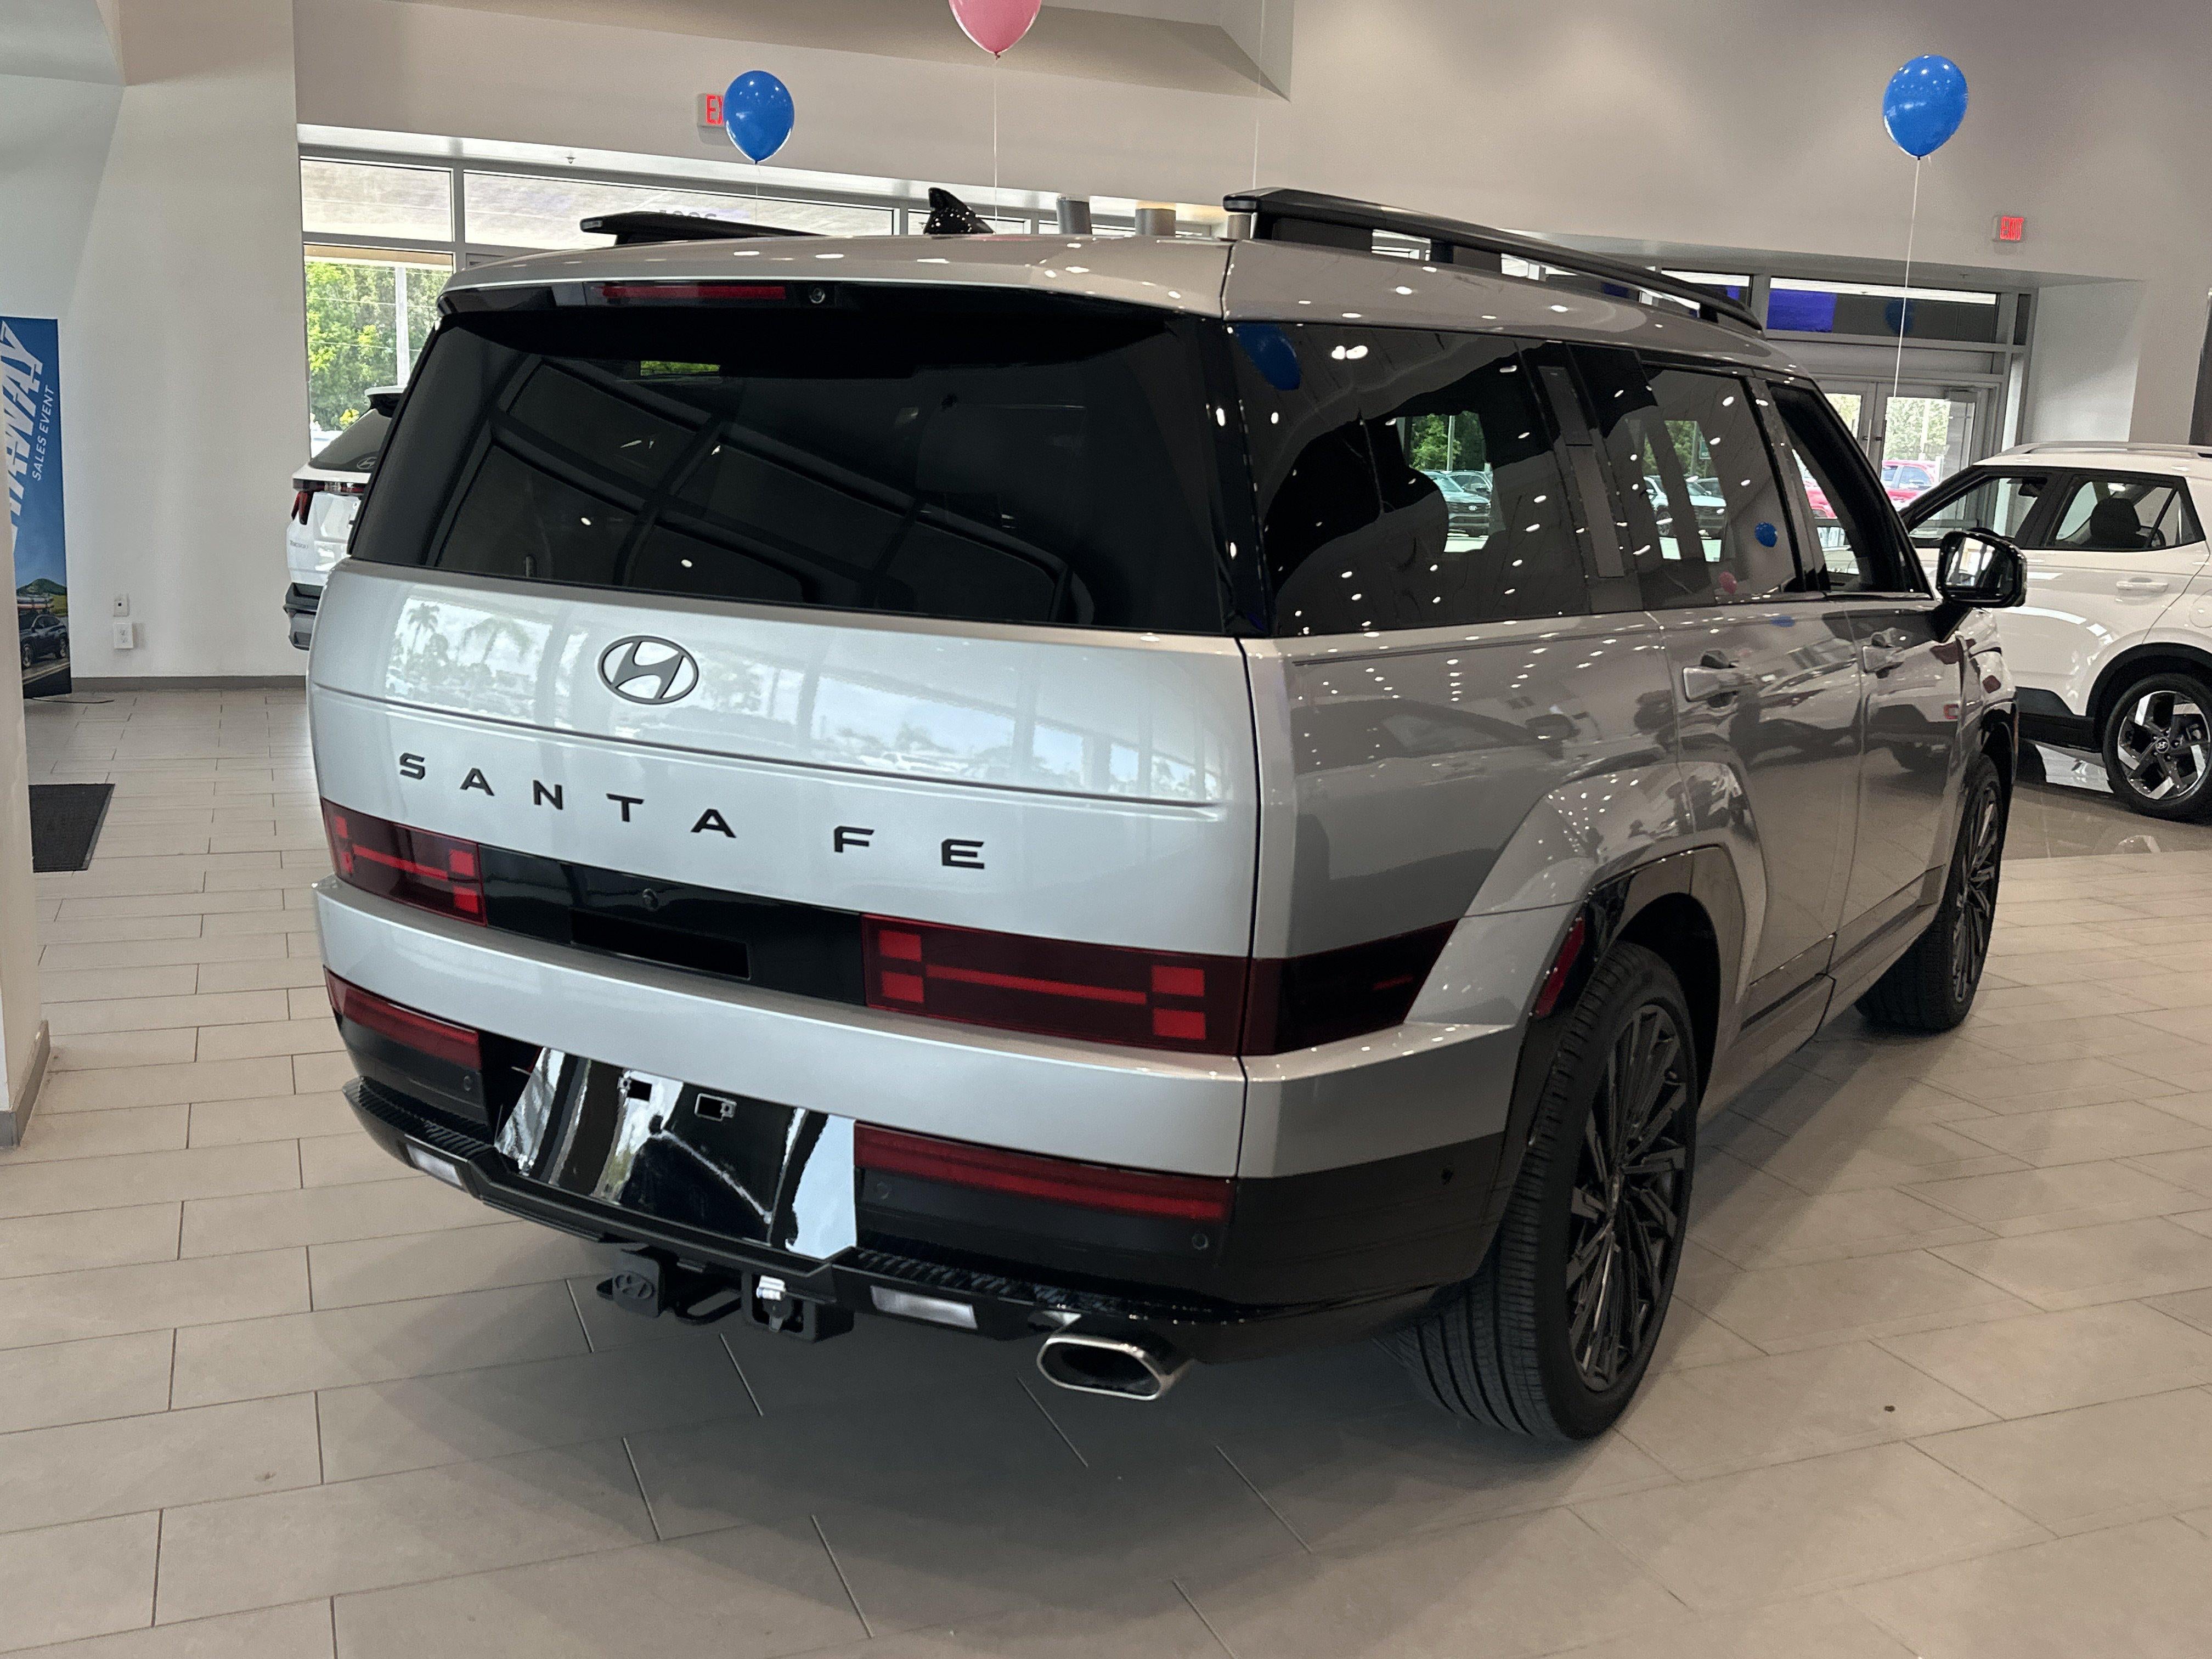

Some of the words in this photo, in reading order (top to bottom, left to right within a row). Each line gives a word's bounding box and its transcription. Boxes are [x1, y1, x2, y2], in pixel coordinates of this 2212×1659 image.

[2000, 216, 2024, 240] EXIT
[39, 385, 54, 434] EVENT
[32, 436, 47, 481] SALES
[399, 752, 736, 839] SANTA
[833, 825, 985, 870] FE
